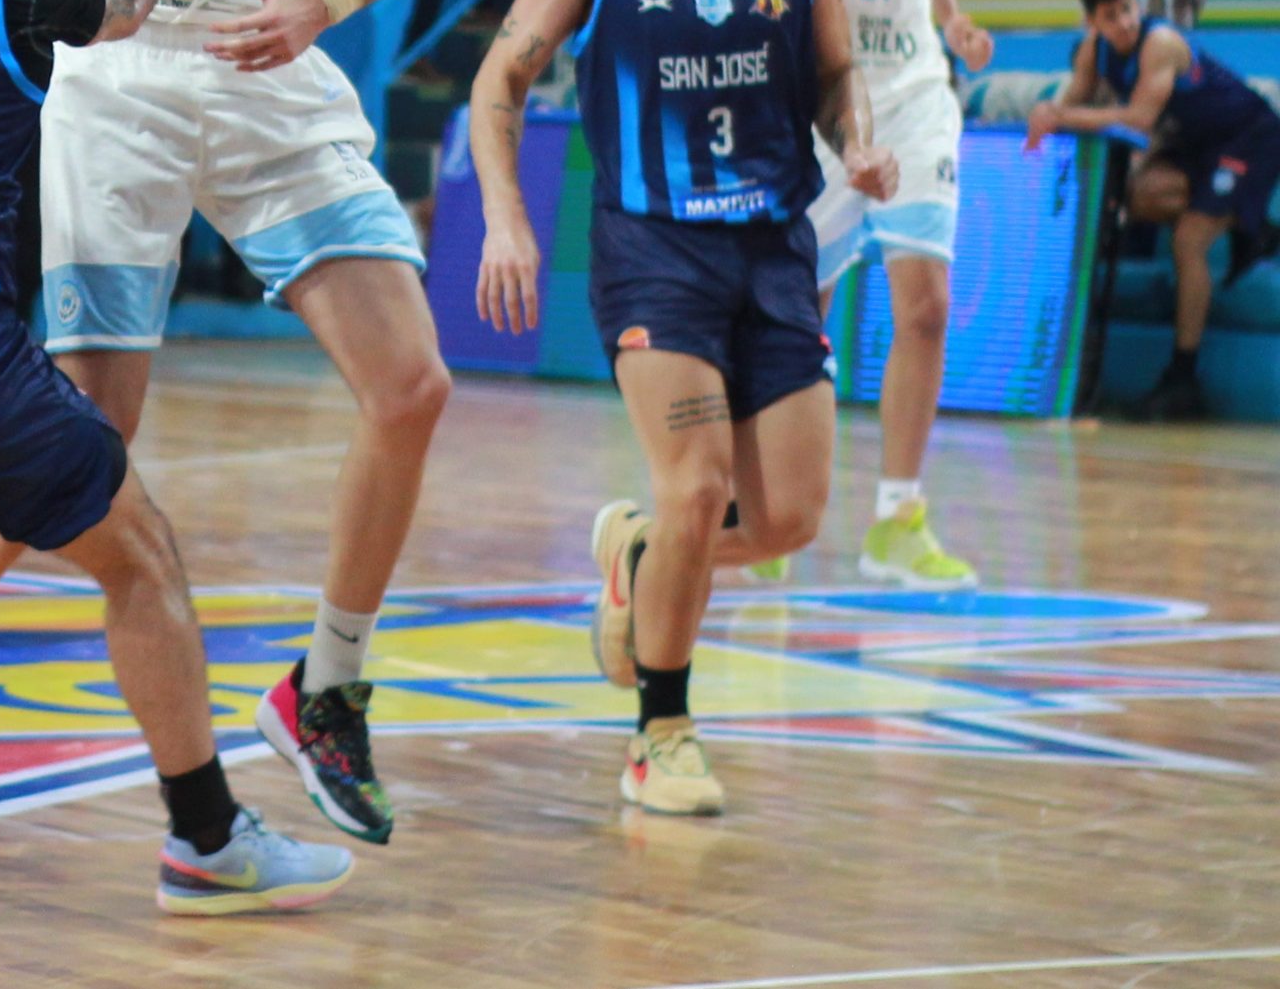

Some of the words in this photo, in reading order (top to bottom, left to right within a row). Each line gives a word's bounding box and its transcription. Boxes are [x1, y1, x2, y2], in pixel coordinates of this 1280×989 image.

[659, 57, 708, 90] SAN
[713, 41, 770, 89] JOSÉ
[707, 105, 735, 157] 3
